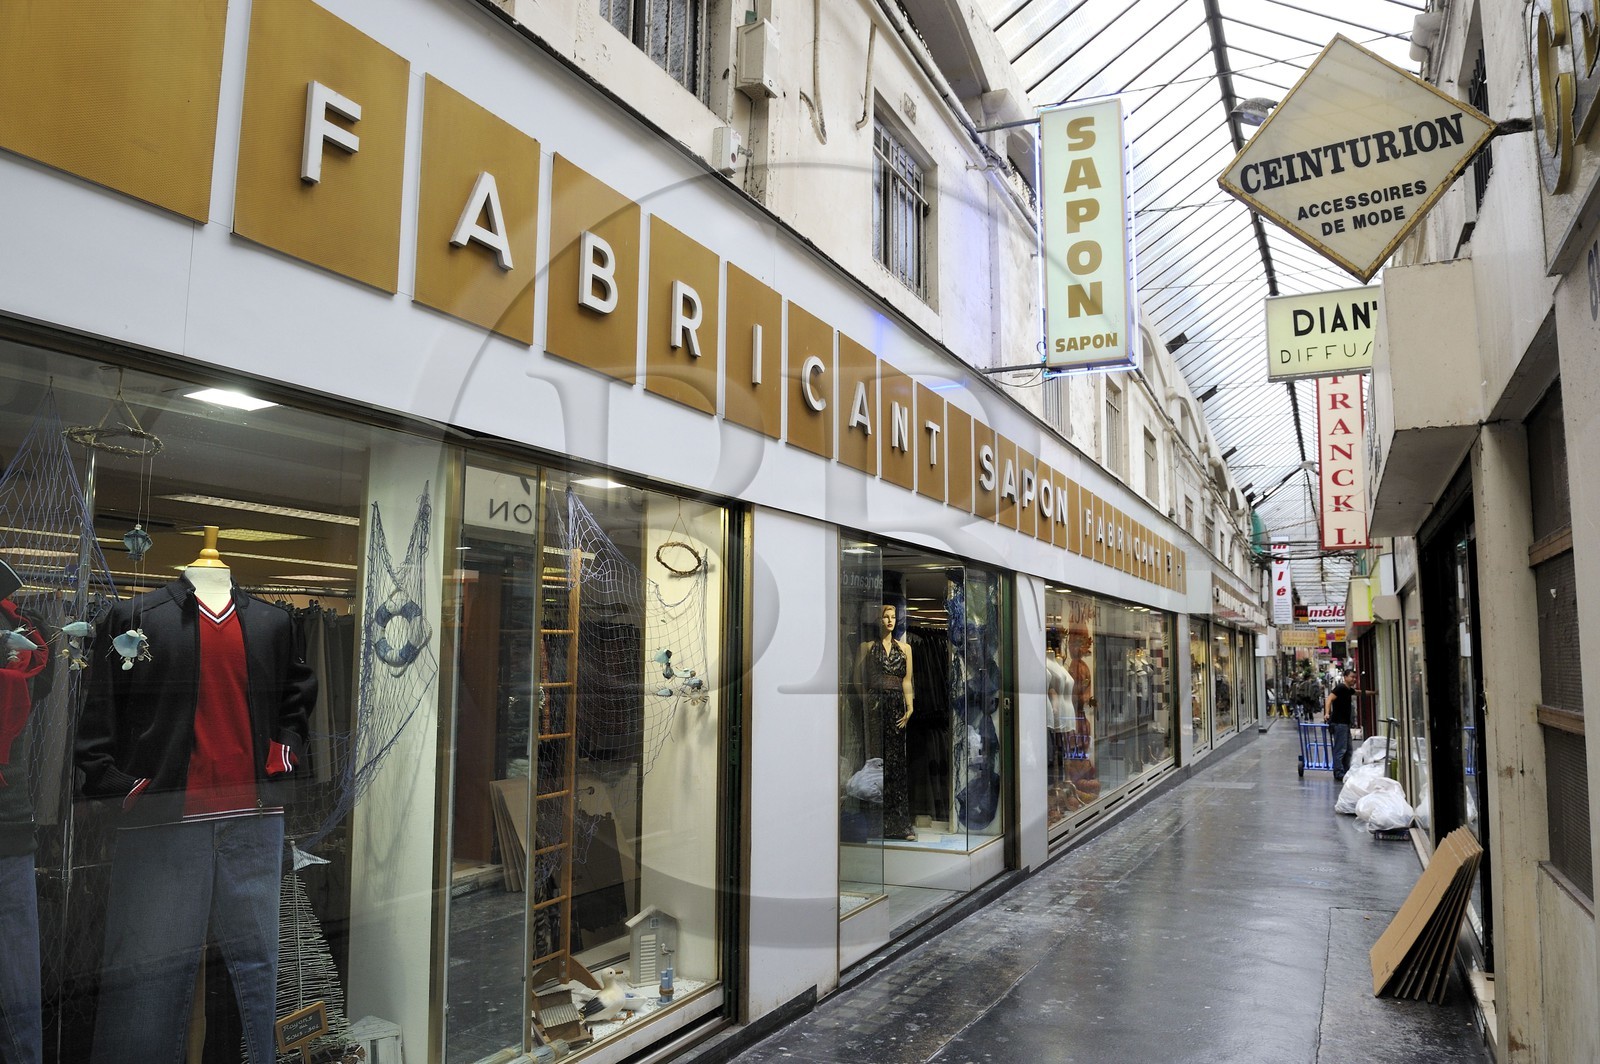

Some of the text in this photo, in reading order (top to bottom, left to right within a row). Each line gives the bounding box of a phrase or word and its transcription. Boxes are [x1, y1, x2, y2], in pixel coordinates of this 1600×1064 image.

[1240, 113, 1464, 194] CEINTURION
[1063, 116, 1103, 318] SAPON
[1298, 180, 1427, 221] ACCESSOIRES
[1321, 206, 1406, 236] DE MODE
[300, 80, 1160, 569] FABRICANT SAPON FABRICANT
[1293, 301, 1378, 336] DIAN
[1055, 332, 1118, 353] SAPON
[1334, 528, 1362, 545] L.
[1309, 605, 1345, 617] mélé
